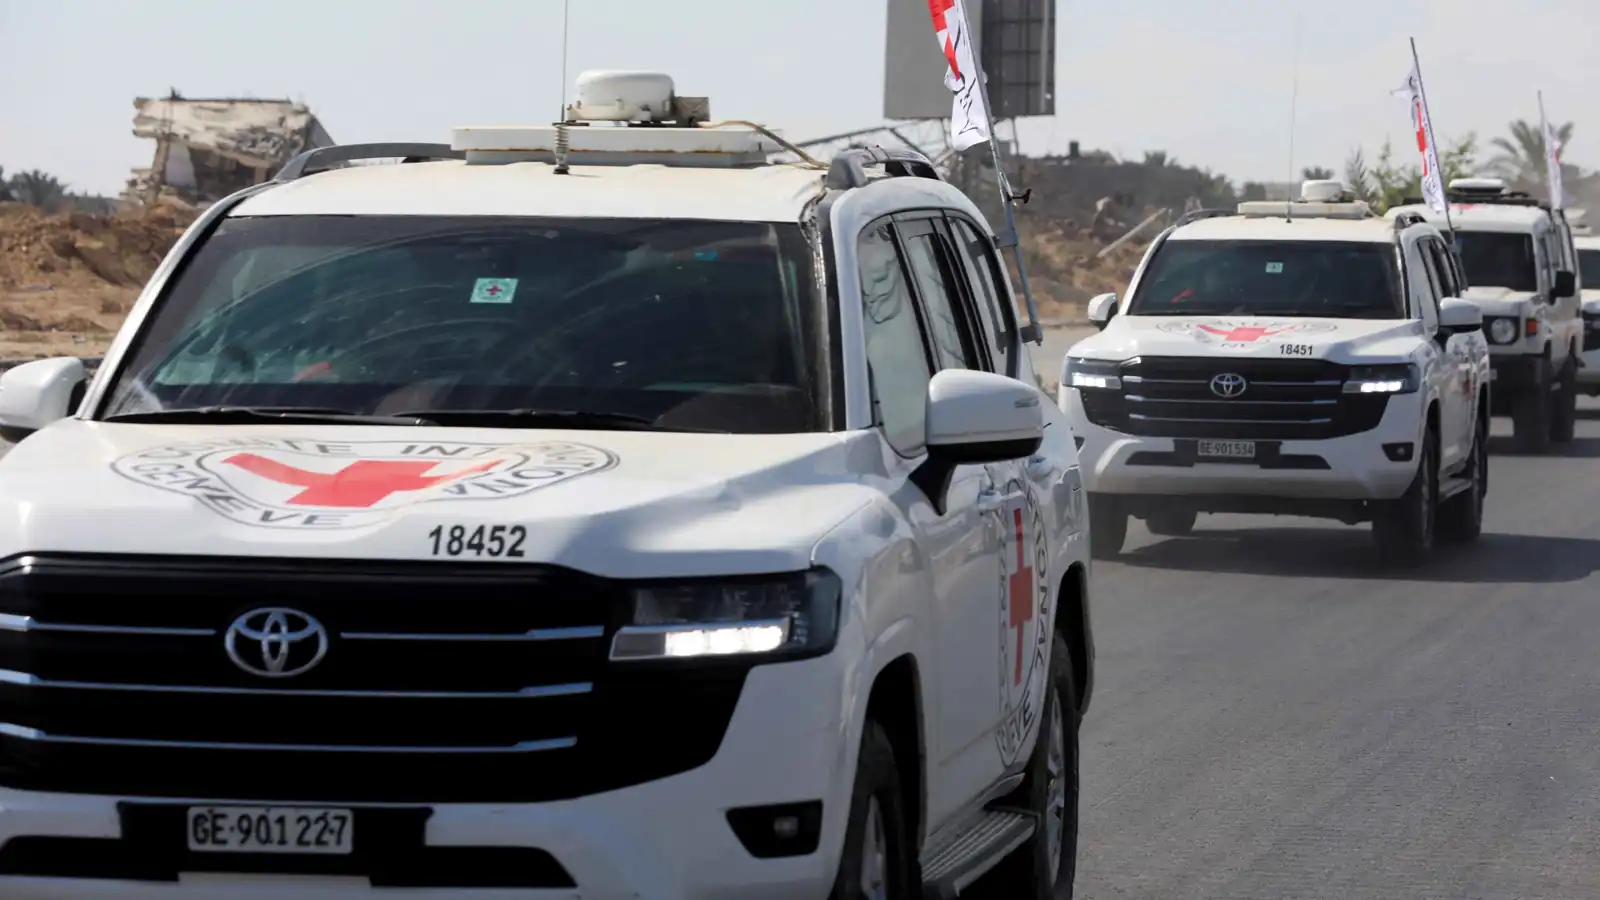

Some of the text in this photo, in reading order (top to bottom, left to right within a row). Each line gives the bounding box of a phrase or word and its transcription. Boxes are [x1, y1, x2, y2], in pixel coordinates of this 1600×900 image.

[1280, 343, 1313, 356] 18451
[131, 462, 351, 526] GENEVE
[428, 524, 527, 558] 18452
